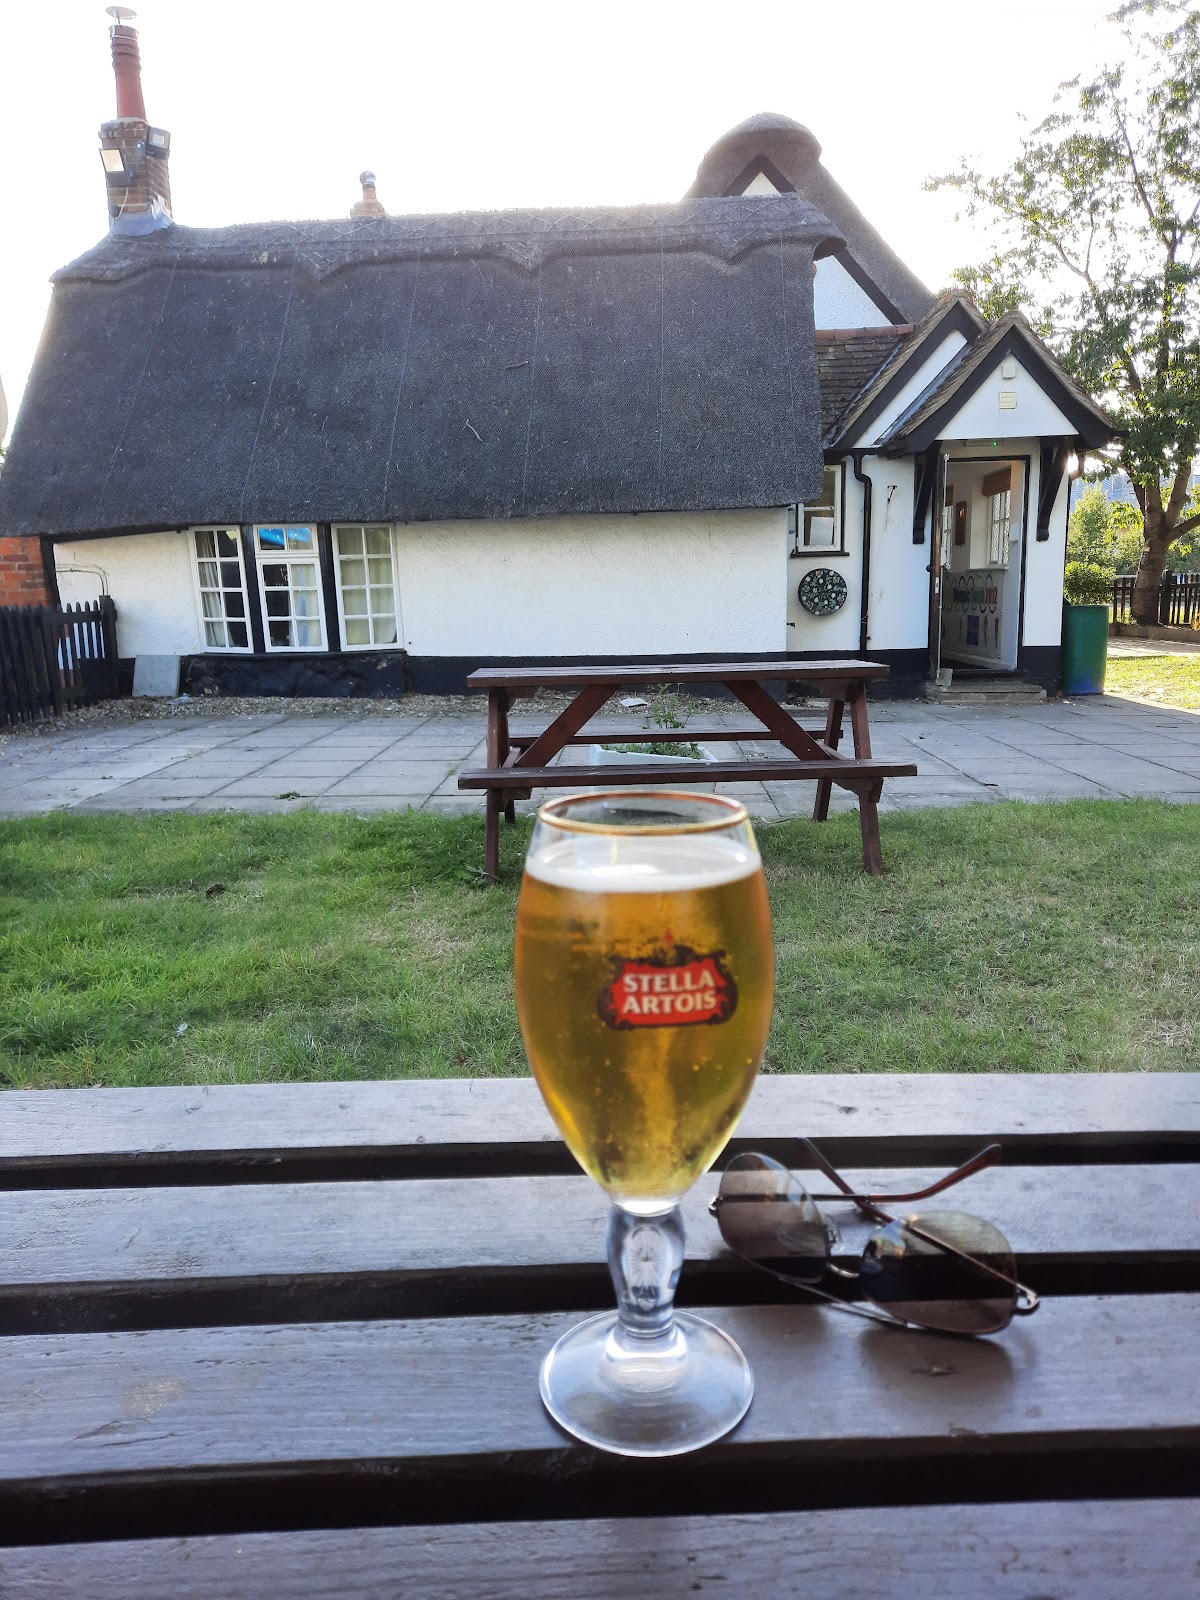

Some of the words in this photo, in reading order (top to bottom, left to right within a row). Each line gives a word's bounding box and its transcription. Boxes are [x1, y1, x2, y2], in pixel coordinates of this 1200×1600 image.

[985, 587, 998, 605] 2012
[624, 970, 715, 993] STELLA
[623, 990, 717, 1014] ARTOIS
